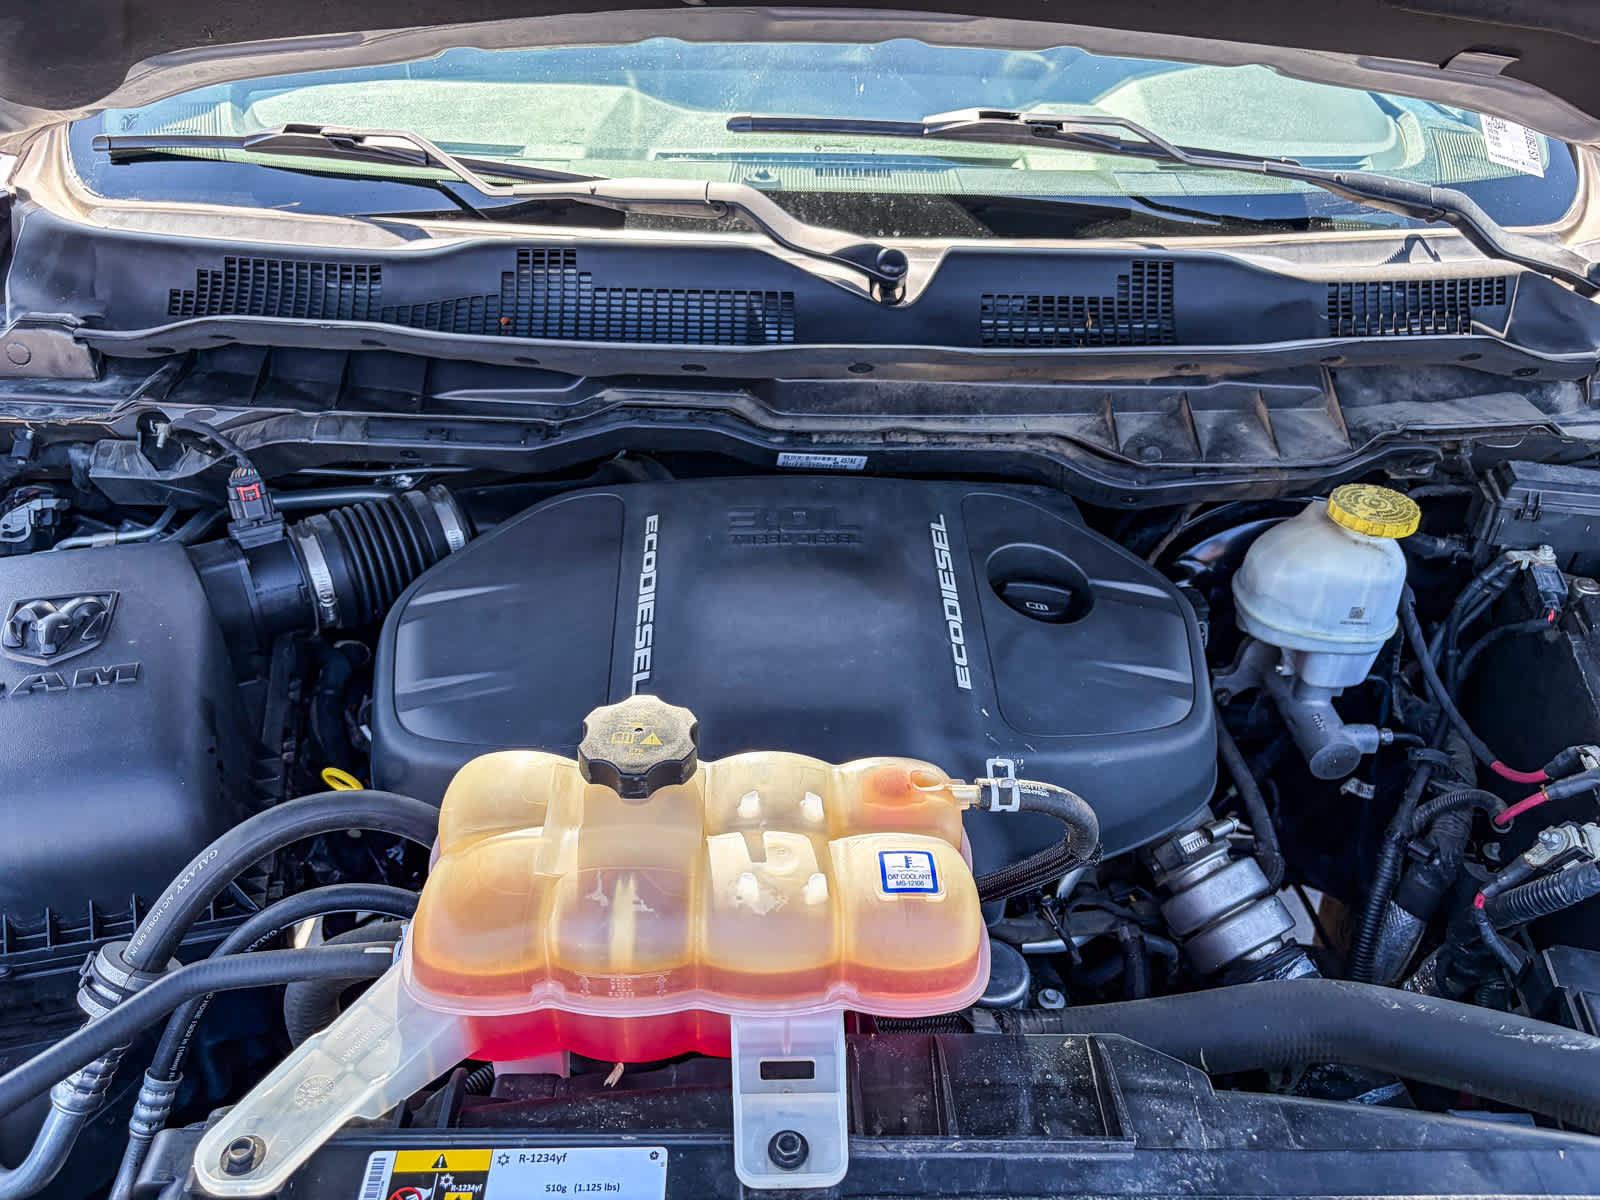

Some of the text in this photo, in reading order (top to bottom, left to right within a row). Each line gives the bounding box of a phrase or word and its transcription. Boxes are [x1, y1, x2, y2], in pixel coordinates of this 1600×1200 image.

[632, 513, 660, 696] ECODIESEL
[930, 512, 973, 691] ECODIESEL
[176, 849, 219, 896] GALAXY
[900, 873, 931, 881] COOLANT
[145, 908, 165, 934] HOSE
[518, 1152, 568, 1166] R-1234yf
[545, 1182, 621, 1195] 510g (1.125 lbs)
